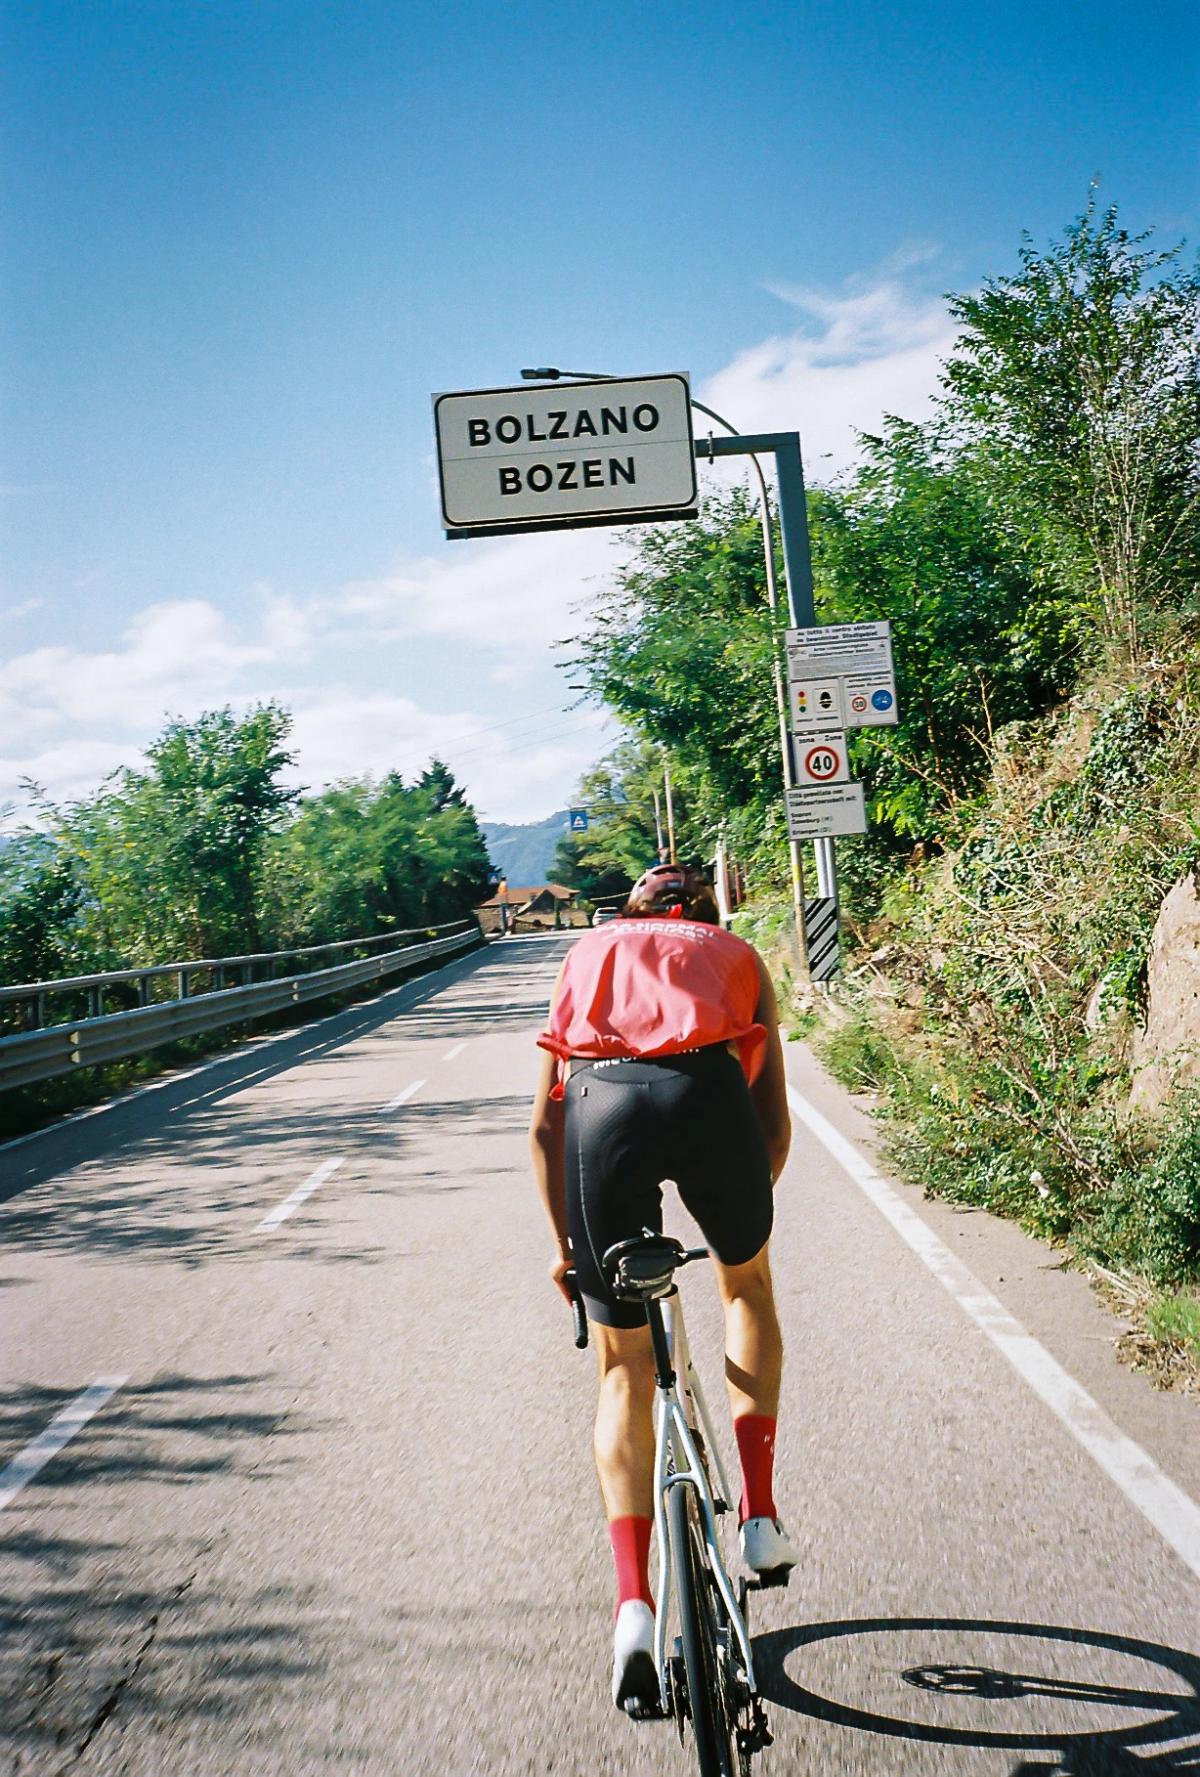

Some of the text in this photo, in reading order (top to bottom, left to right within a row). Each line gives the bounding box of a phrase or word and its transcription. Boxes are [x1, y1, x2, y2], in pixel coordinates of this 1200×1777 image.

[468, 403, 659, 447] BOLZANO
[498, 456, 636, 495] BOZEN
[812, 755, 833, 772] 40
